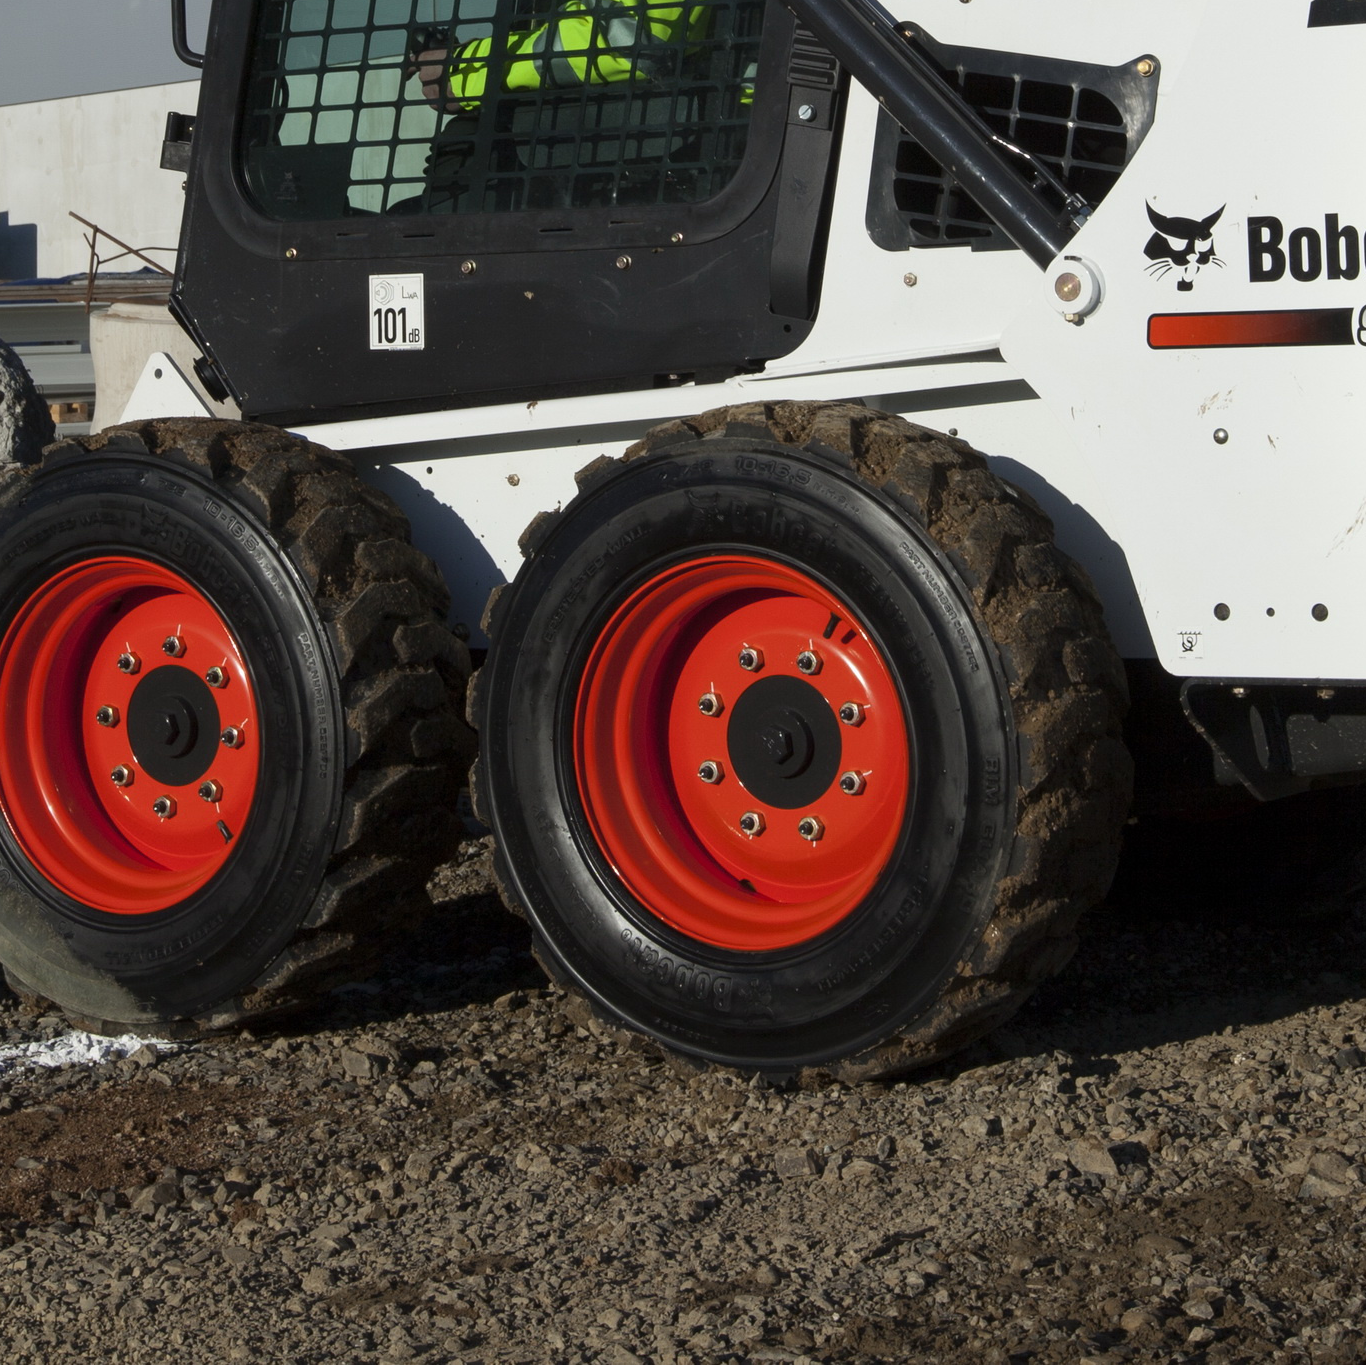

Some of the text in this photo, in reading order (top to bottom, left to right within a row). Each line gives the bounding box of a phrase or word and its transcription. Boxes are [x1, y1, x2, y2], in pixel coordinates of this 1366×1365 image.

[373, 307, 421, 344] 101 dB
[735, 457, 813, 486] 10-16.5
[201, 495, 260, 555] 10-16.5
[297, 631, 315, 670] PART
[982, 756, 1001, 806] RIM
[618, 936, 733, 1012] Bobcat
